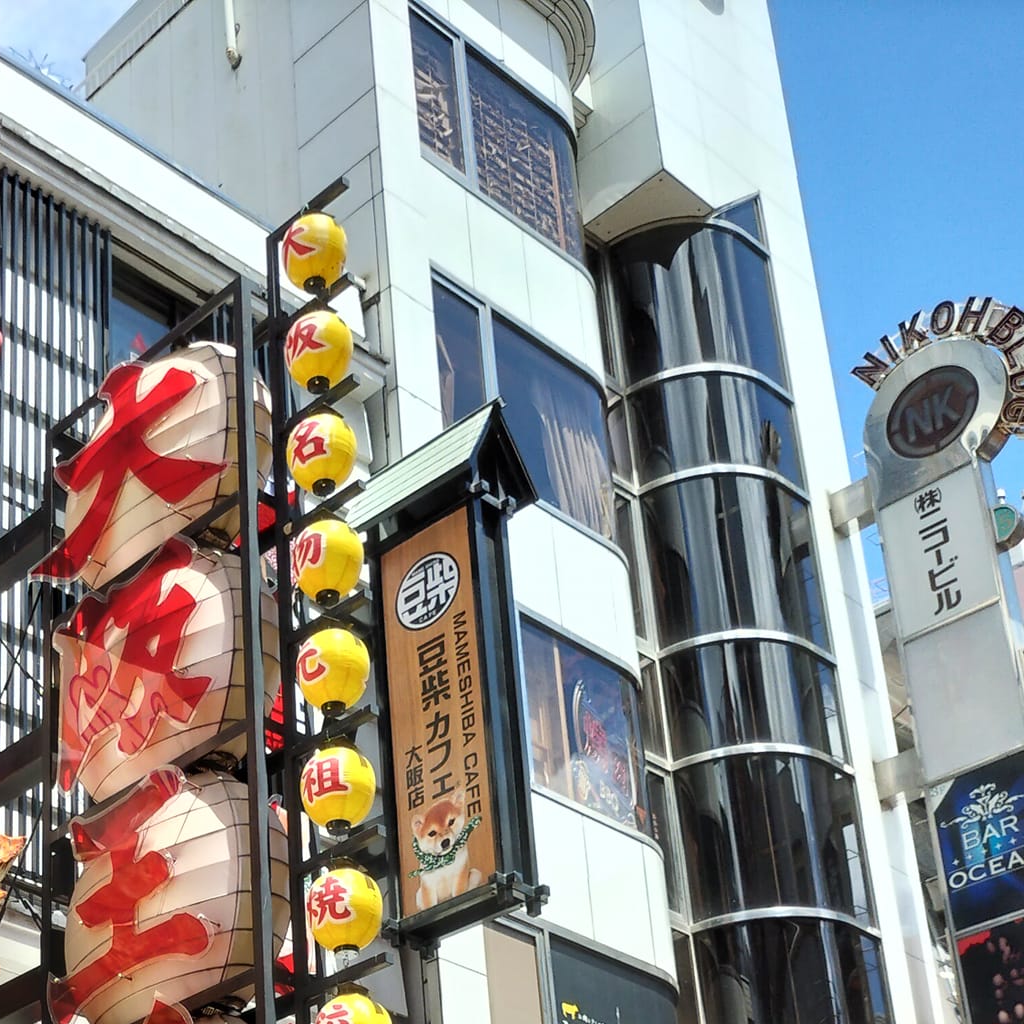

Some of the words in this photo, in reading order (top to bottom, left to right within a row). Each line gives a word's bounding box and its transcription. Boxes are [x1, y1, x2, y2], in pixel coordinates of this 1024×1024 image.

[850, 296, 993, 390] NIKOH
[904, 385, 961, 444] NK
[452, 611, 477, 747] MAMESHIBA
[405, 745, 424, 811] 大阪店
[462, 754, 483, 818] CAFE
[961, 815, 1019, 851] BAR
